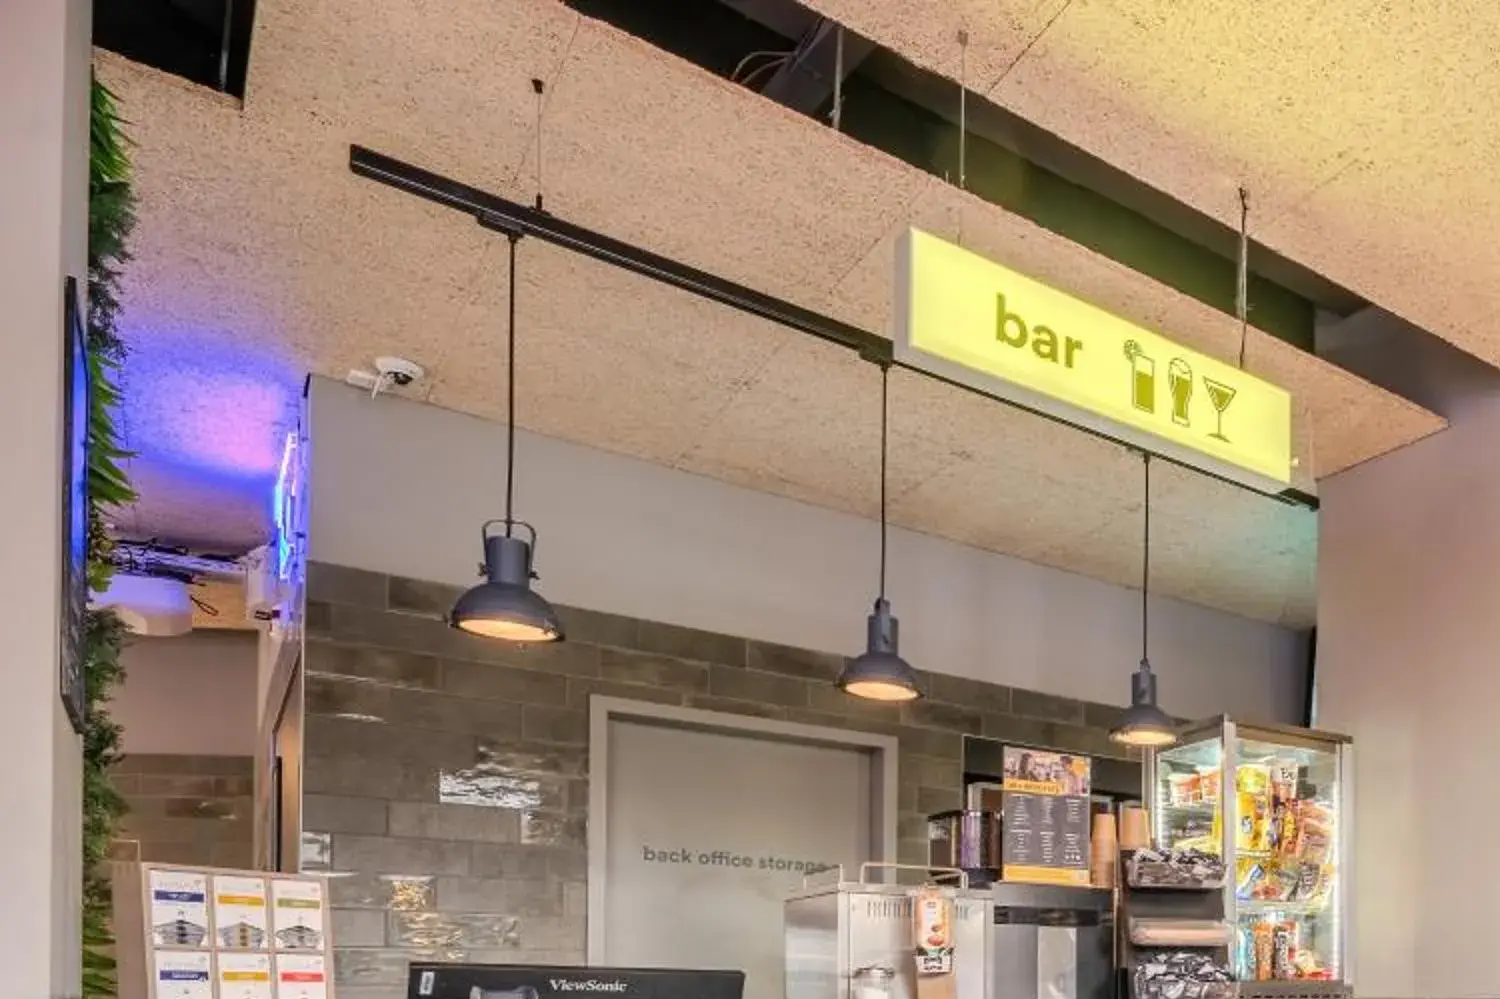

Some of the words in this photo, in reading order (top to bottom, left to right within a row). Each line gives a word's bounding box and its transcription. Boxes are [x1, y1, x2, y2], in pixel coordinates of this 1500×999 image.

[995, 292, 1084, 369] bar
[642, 845, 694, 864] back
[698, 851, 753, 868] office
[549, 978, 628, 992] ViewSonic
